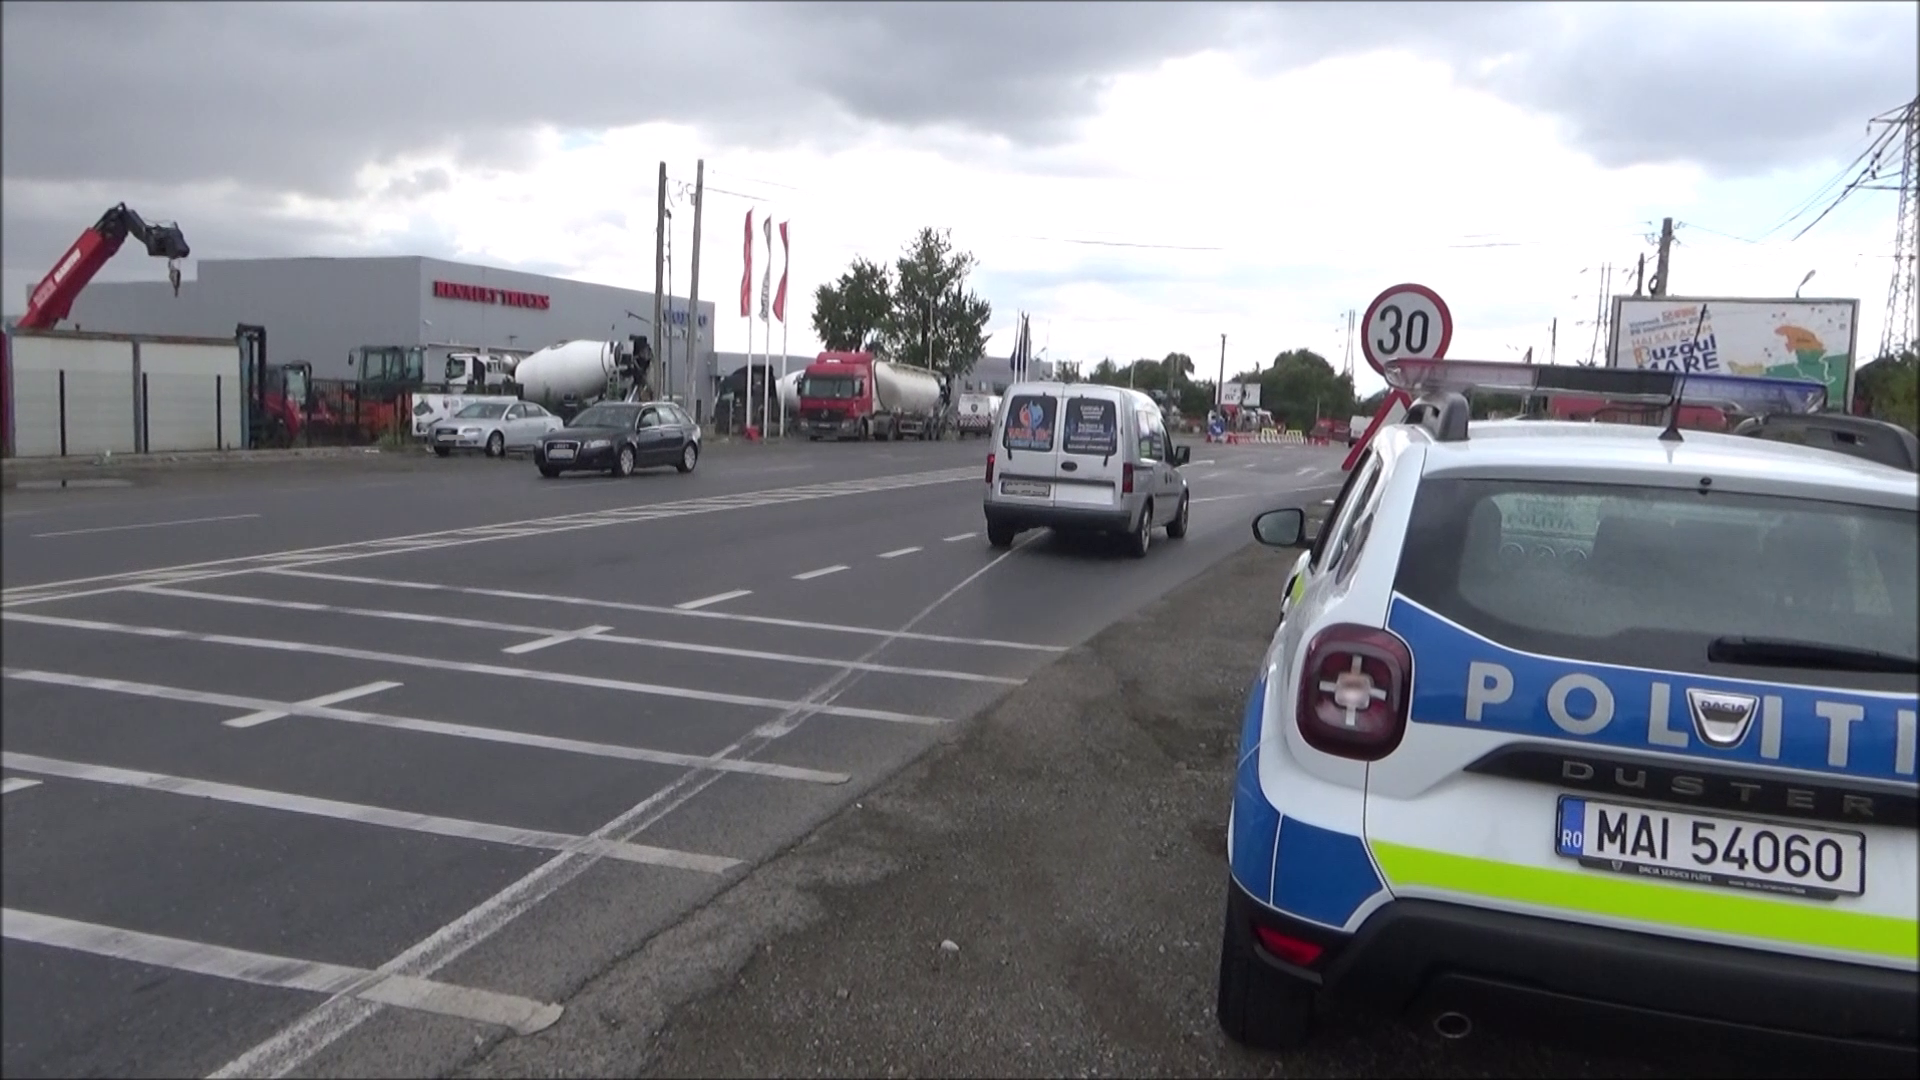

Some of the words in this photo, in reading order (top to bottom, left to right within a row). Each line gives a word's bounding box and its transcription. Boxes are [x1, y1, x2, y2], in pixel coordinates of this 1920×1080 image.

[433, 280, 498, 304] RENAULT
[498, 289, 549, 310] TRUCKS
[1377, 304, 1429, 354] 30
[1701, 700, 1746, 712] DACIA
[1561, 760, 1874, 817] DUSTER
[1562, 829, 1582, 848] RO
[1597, 810, 1669, 860] MAI
[1692, 820, 1843, 882] 54060
